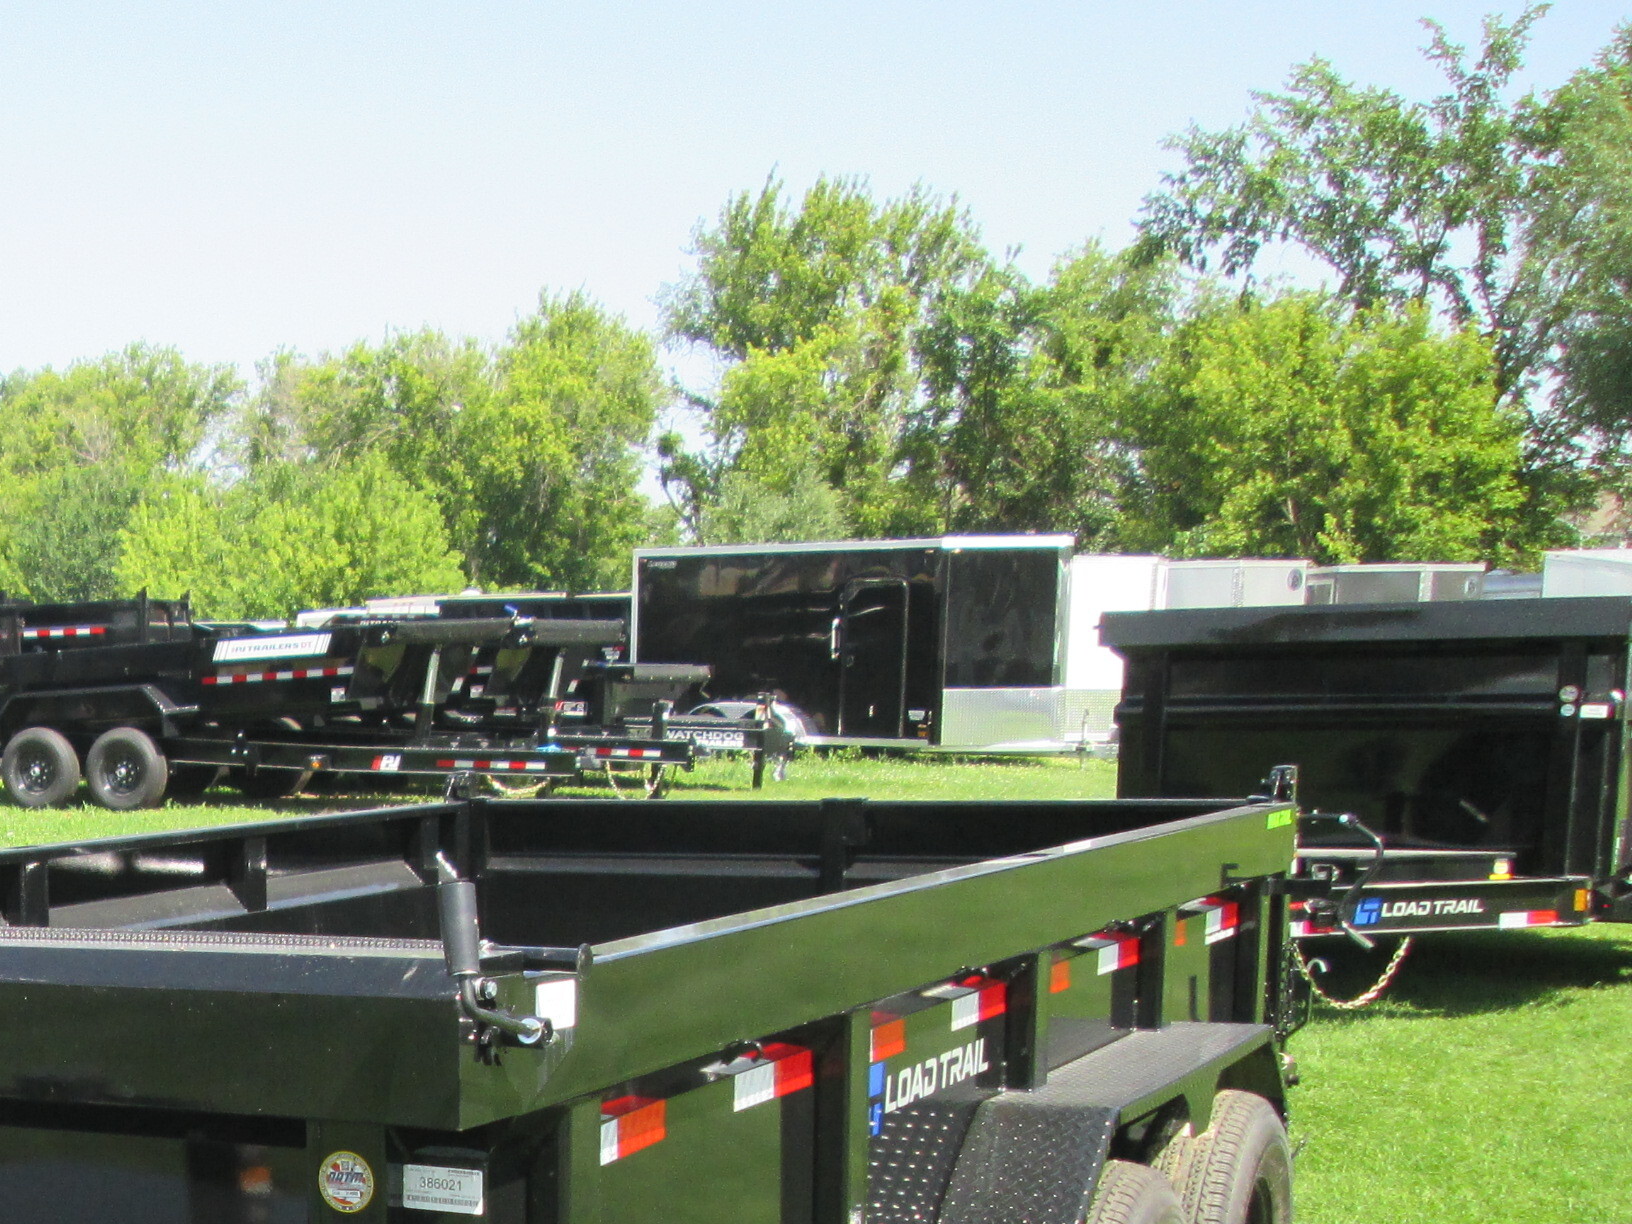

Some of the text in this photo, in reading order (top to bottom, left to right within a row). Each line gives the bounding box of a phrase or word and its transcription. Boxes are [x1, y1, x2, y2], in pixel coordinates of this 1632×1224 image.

[1380, 898, 1484, 918] LOAD TRAIL
[884, 1038, 988, 1114] LOAD TRAIL
[420, 1177, 462, 1191] 386021
